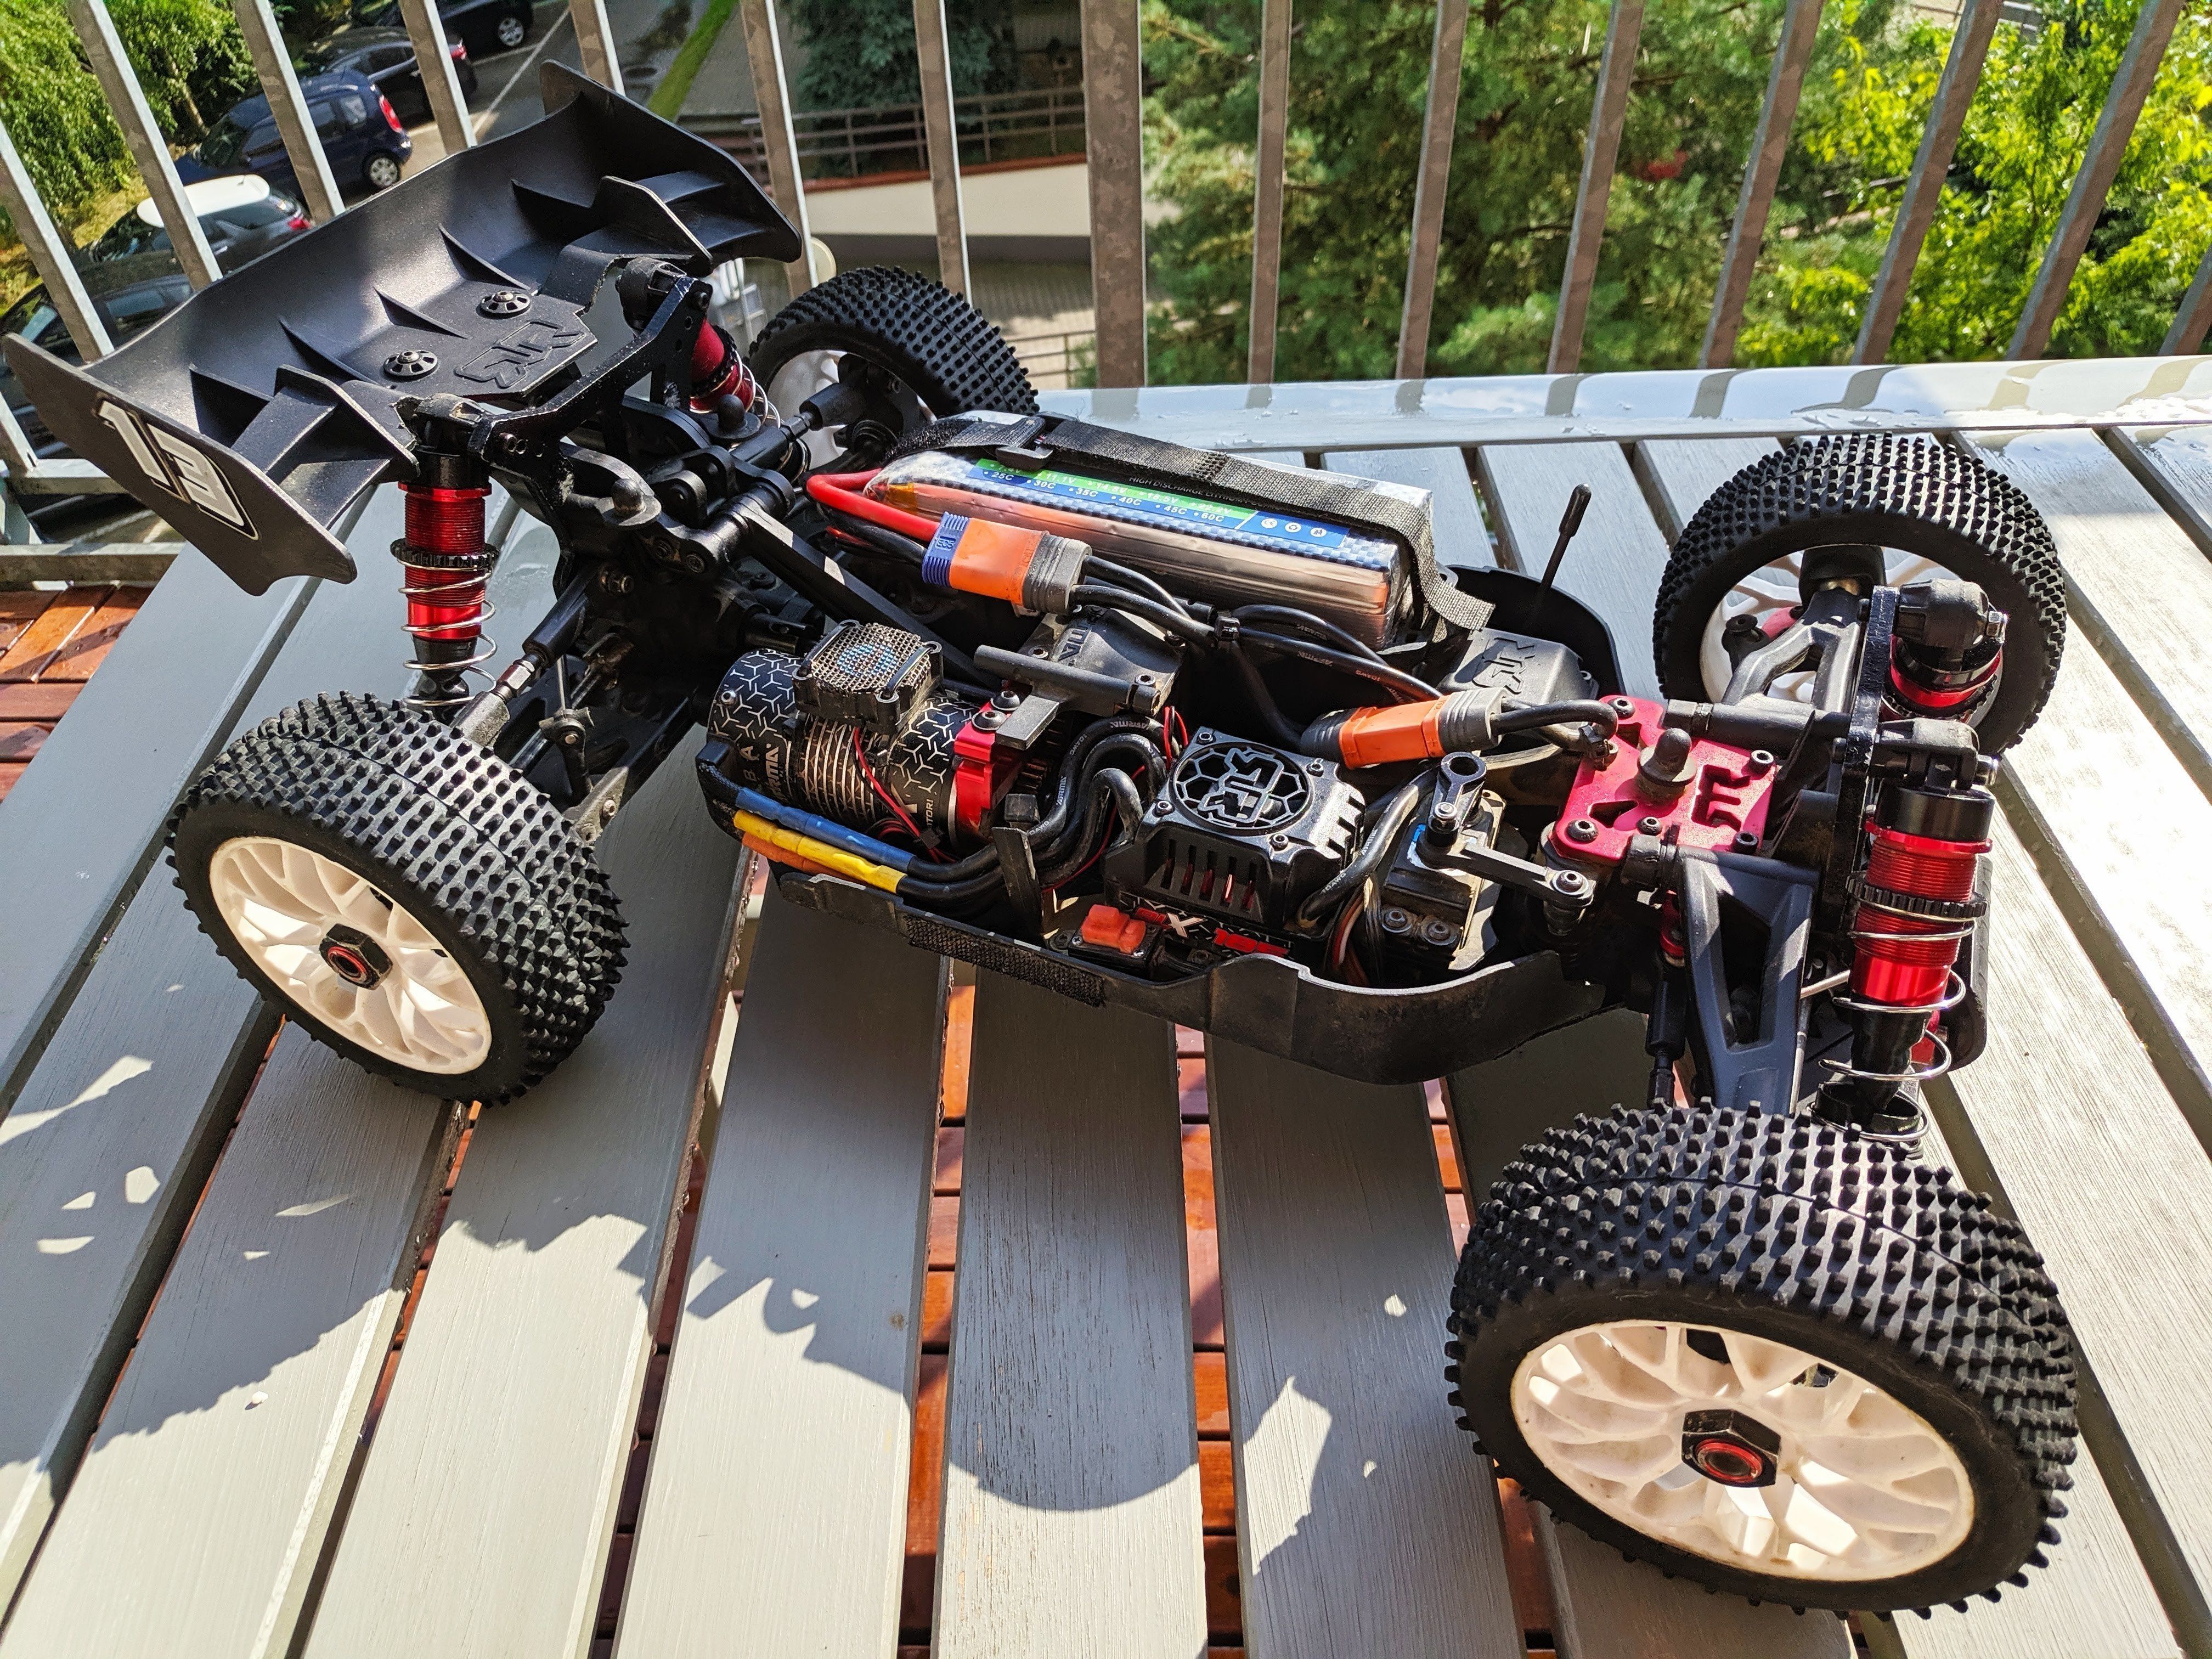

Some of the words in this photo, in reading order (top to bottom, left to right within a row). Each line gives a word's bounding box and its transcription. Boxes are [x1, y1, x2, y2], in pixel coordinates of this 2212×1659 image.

[1046, 473, 1076, 484] 11.1V
[1146, 492, 1180, 505] 18.5V
[1128, 476, 1152, 486] HIGH
[1320, 476, 1358, 486] QUALITY
[991, 471, 1014, 481] 25C
[1033, 479, 1057, 489] 30C
[1075, 488, 1098, 498] 35C
[1118, 496, 1142, 506] 40C
[1163, 505, 1187, 515] 45C
[1200, 512, 1224, 522] 60C
[1028, 820, 1050, 836] 0AWG
